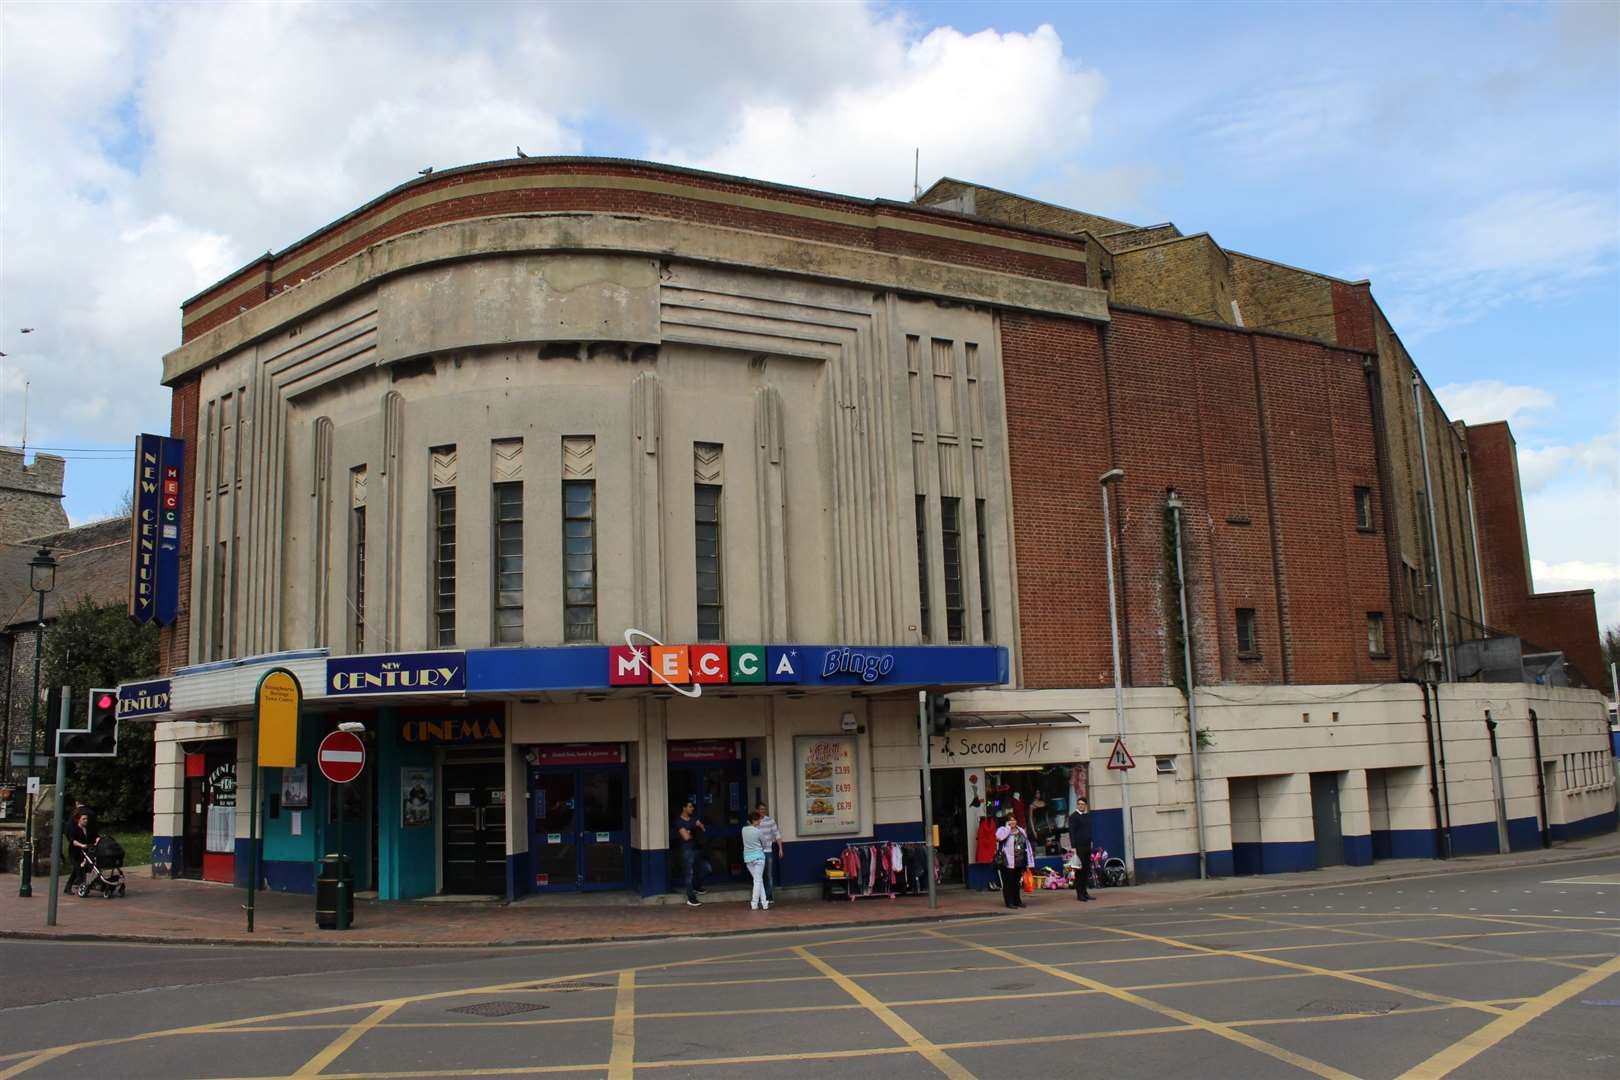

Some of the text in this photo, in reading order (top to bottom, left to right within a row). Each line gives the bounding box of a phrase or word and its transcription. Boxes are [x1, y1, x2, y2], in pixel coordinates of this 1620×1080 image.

[163, 469, 177, 536] MECC
[139, 452, 157, 608] NEW CENTURY
[382, 662, 400, 670] NEW
[619, 653, 795, 676] MECCA
[823, 648, 894, 681] Bingo
[333, 667, 458, 691] CENTURY
[117, 693, 168, 713] CENTURY
[402, 719, 503, 742] CINEMA
[960, 732, 1048, 760] Second style
